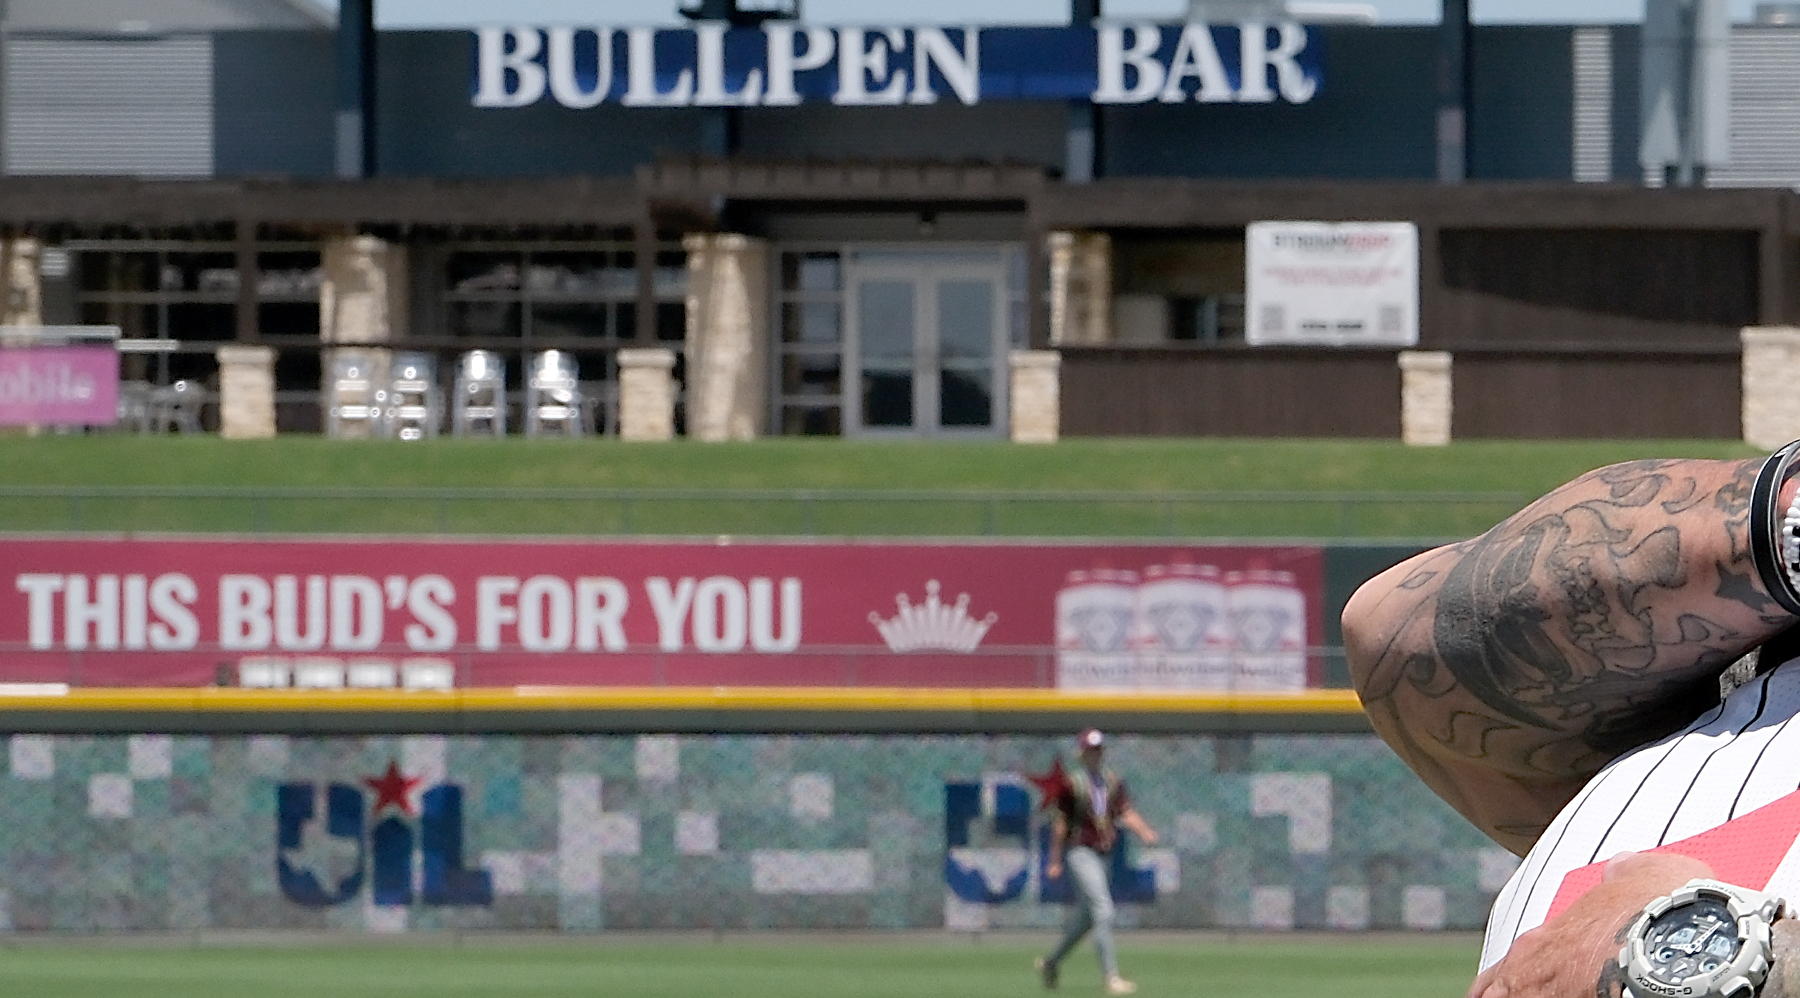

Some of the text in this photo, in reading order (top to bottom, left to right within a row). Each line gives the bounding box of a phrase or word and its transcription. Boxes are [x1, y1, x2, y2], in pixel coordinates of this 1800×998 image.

[472, 17, 1317, 109] BULLPEN BAR
[16, 572, 802, 655] THIS BUD'S FOR YOU
[1635, 973, 1693, 996] G-SHOCK
